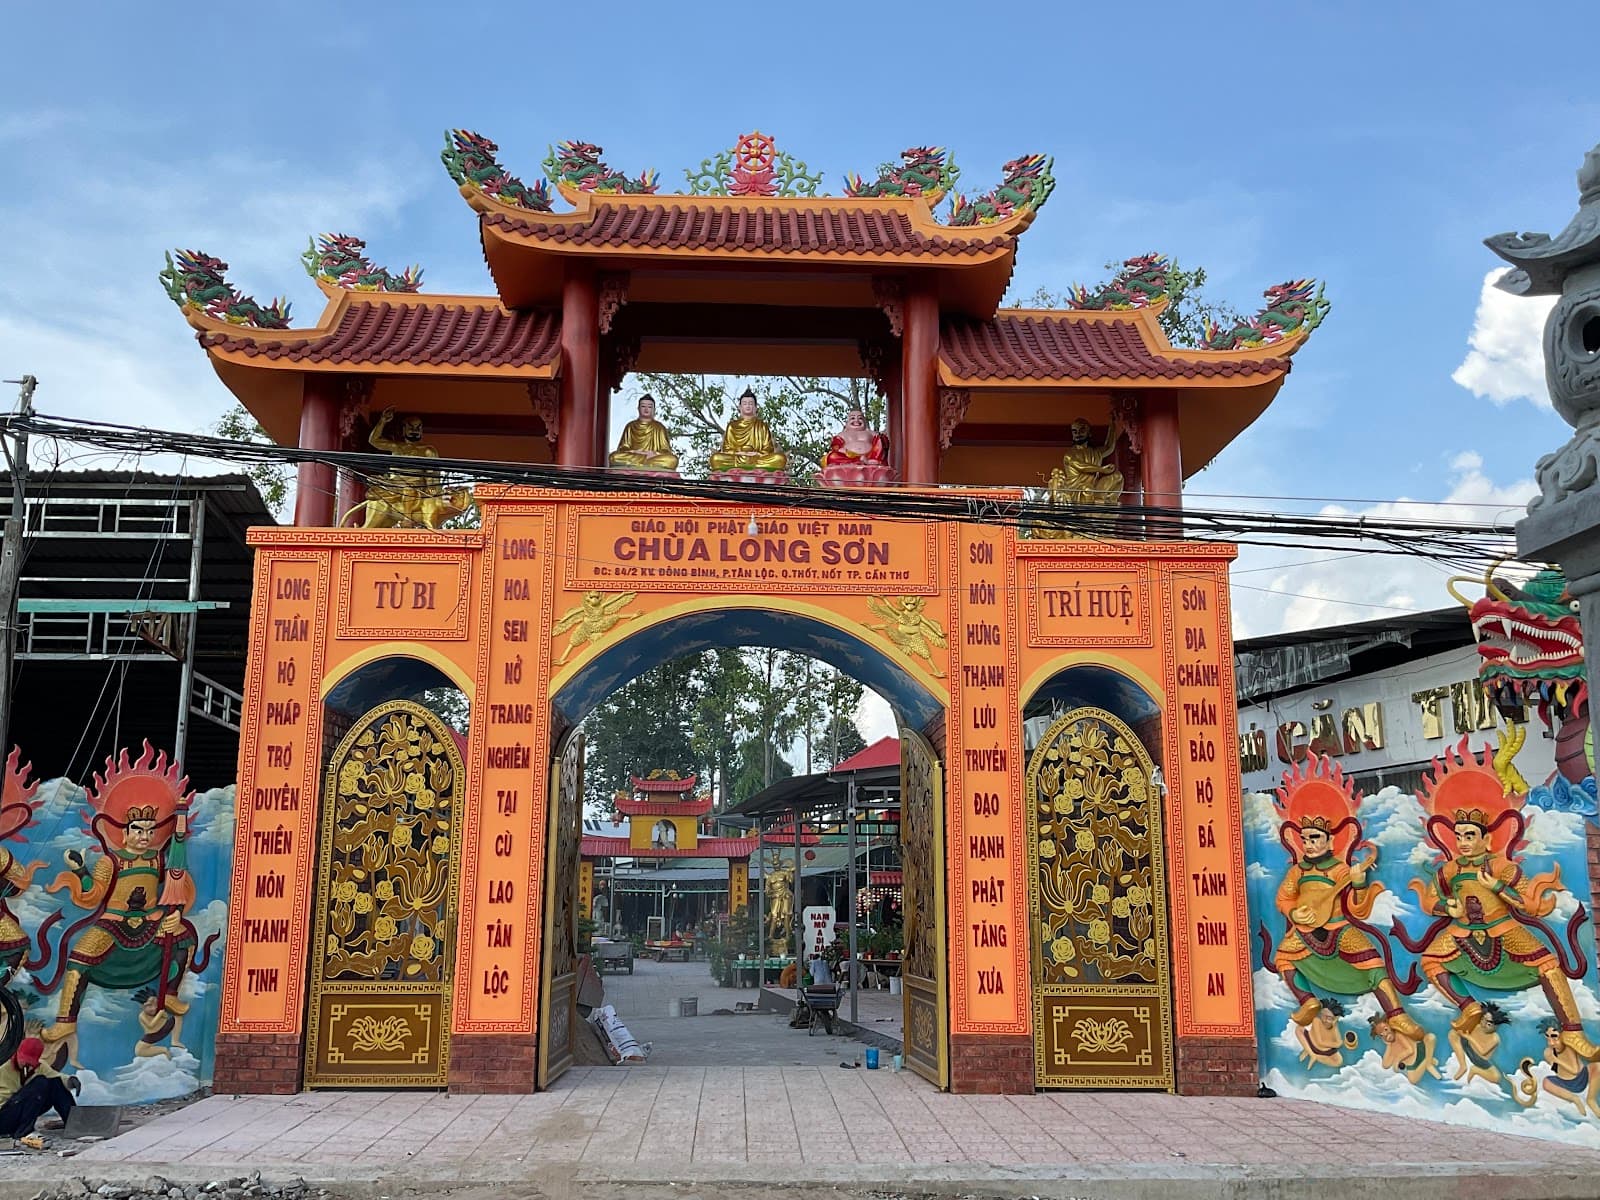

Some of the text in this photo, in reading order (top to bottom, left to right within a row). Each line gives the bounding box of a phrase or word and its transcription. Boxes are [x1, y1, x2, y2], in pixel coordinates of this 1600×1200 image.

[631, 519, 872, 537] GIÁO HỘI PHẬT GIÁO VIỆT NAM
[613, 532, 889, 565] CHÙA LONG SƠN
[970, 541, 992, 564] SƠN
[614, 566, 637, 576] 84/2
[847, 570, 862, 579] TP.
[889, 570, 910, 580] THƠ
[374, 572, 437, 609] TỪ BI
[970, 580, 995, 605] MÔN
[1043, 581, 1133, 625] TRÍ HUỆ
[1182, 586, 1206, 610] SƠN
[967, 621, 1000, 645] HƯNG
[1186, 628, 1206, 652] ĐỊA
[964, 666, 1004, 692] THẠNH
[1177, 662, 1220, 688] CHÁNH
[974, 704, 996, 728] LƯU
[1190, 732, 1214, 762] BẢO
[484, 539, 536, 998] LONG HOA SEN NỞ TRANG NGHIÊM TẠI CÙ LAO TÂN LỘC
[243, 578, 310, 995] LONG THẦN HỘ PHÁP TRỢ DUYÊN THIỀN MÔN THANH TỊNH
[1196, 777, 1213, 807] HỘ
[974, 793, 999, 817] ĐẠO
[1199, 820, 1215, 848] BÁ
[970, 836, 1004, 861] HẠNH
[972, 876, 1004, 906] PHẬT
[1192, 867, 1227, 896] TÁNH
[973, 920, 1006, 947] TĂNG
[1197, 916, 1227, 945] BÌNH
[978, 966, 1003, 994] XƯA
[1208, 973, 1224, 996] AN
